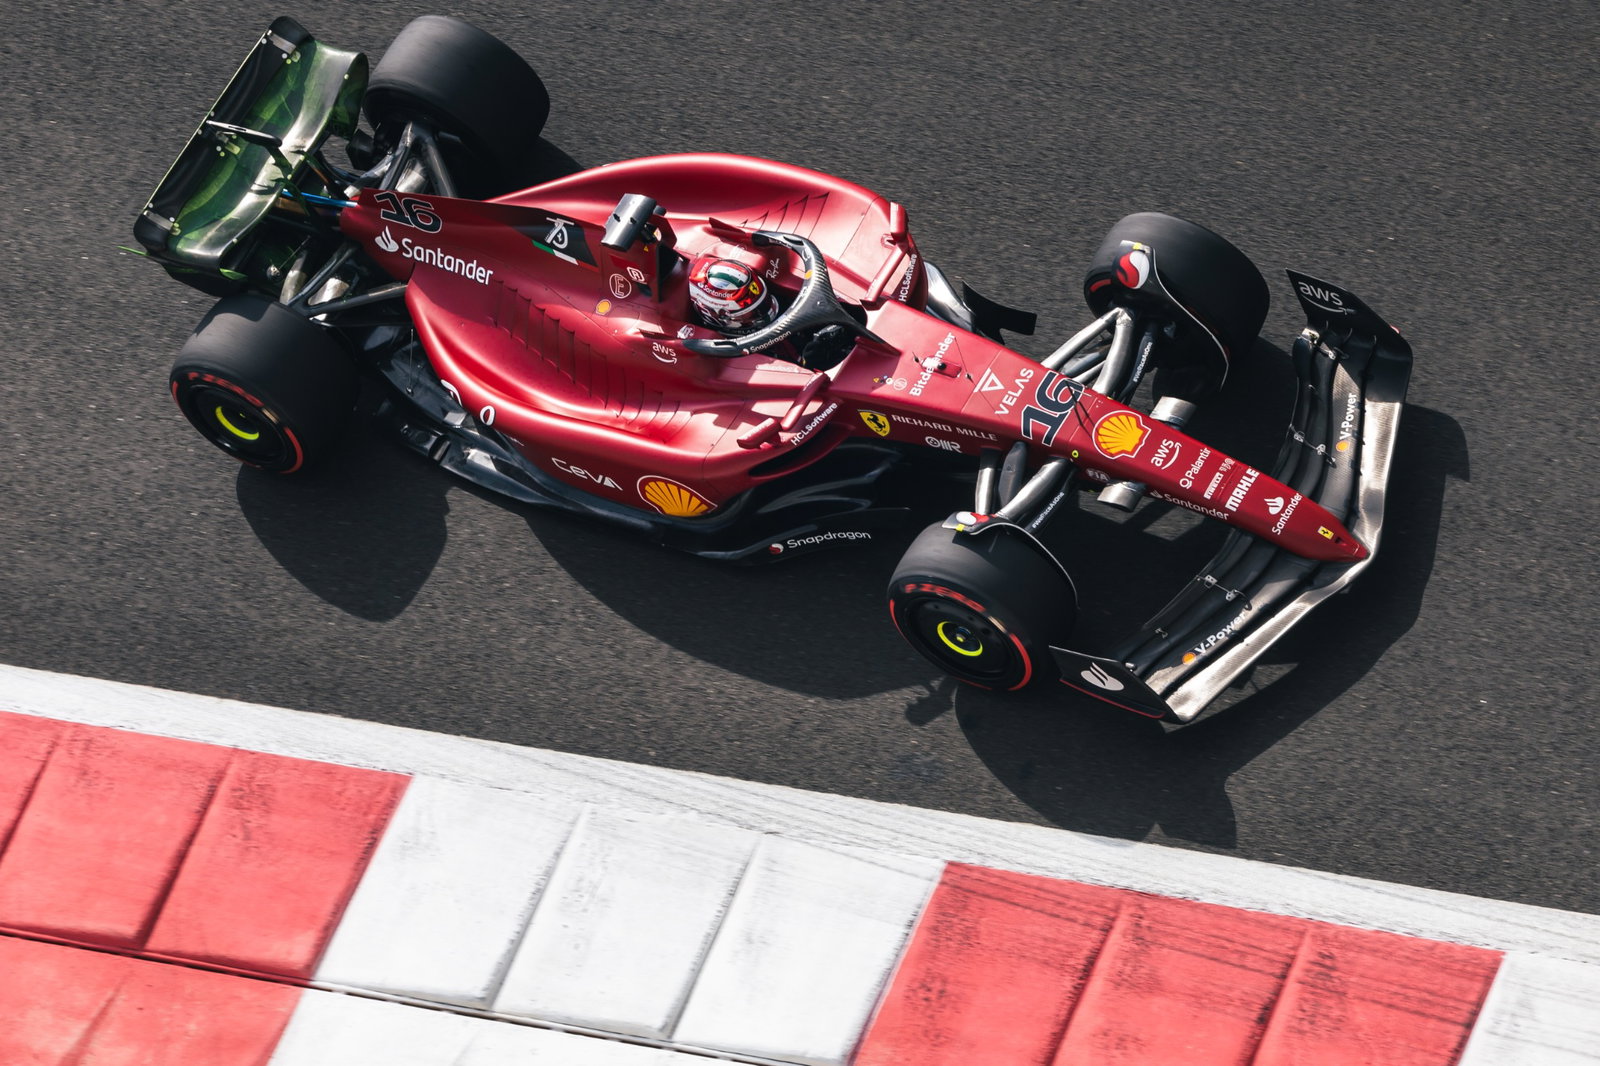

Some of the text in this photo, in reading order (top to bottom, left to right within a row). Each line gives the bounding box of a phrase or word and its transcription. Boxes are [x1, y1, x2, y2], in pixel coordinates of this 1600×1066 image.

[374, 190, 443, 233] 16
[401, 237, 494, 285] Santander
[703, 284, 734, 298] Santander
[1298, 281, 1344, 306] aws
[652, 341, 677, 358] aws
[750, 329, 792, 352] Snapdragon
[994, 367, 1035, 415] VELAS
[1021, 369, 1086, 447] 16
[790, 402, 839, 446] HCLSoftware
[891, 414, 998, 442] RICHARD MILLE
[1339, 392, 1358, 440] V-Power
[1150, 438, 1175, 467] aws
[1186, 447, 1212, 480] Palantir
[1164, 493, 1229, 521] Santander
[1224, 467, 1260, 512] MAHLE
[1271, 492, 1303, 535] Santander
[786, 530, 872, 549] Snapdragon
[1194, 611, 1246, 656] V-Power
